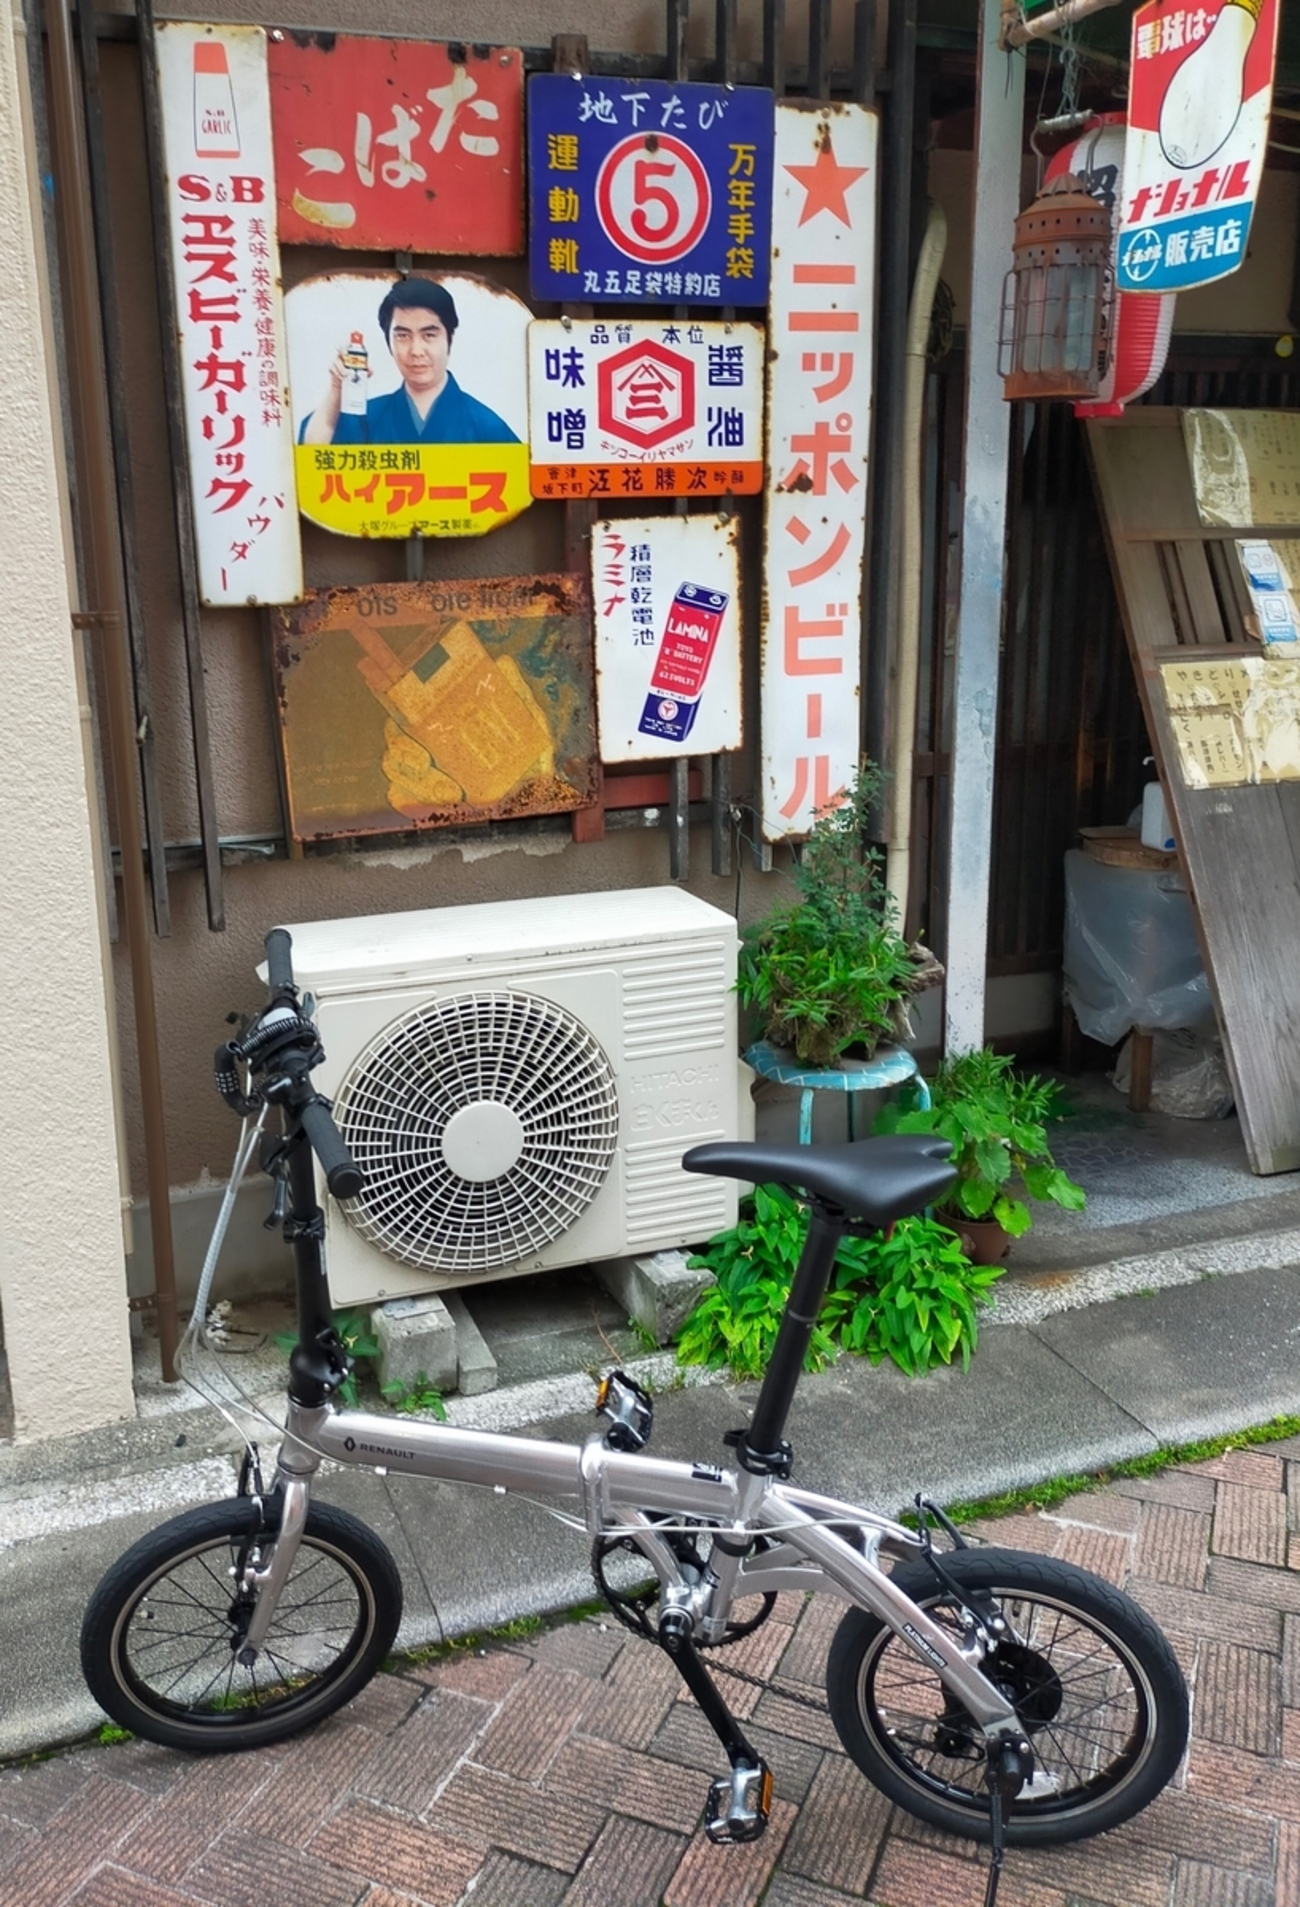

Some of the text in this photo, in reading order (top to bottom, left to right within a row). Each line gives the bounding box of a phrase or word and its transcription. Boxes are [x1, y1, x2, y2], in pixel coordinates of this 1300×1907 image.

[579, 91, 729, 130] 地下たび
[292, 63, 500, 229] たばこ
[177, 174, 266, 204] S&B
[547, 134, 580, 275] 運動靴
[725, 143, 757, 279] 万年手袋
[1127, 159, 1251, 225] ナショナル
[1164, 218, 1243, 268] 販売店
[583, 269, 721, 298] 丸五足袋特約店
[181, 212, 254, 515] エスビーガーリック
[544, 346, 586, 450] 味噌
[314, 449, 421, 471] 強力殺虫剤
[319, 471, 509, 515] ハイアース
[778, 263, 860, 821] ニッポンビール
[600, 533, 627, 617] ラミナ
[629, 543, 655, 646] 積層乾電池
[667, 617, 710, 643] LAMINA
[630, 1063, 719, 1094] HITACHI
[360, 1443, 416, 1460] RENAULT
